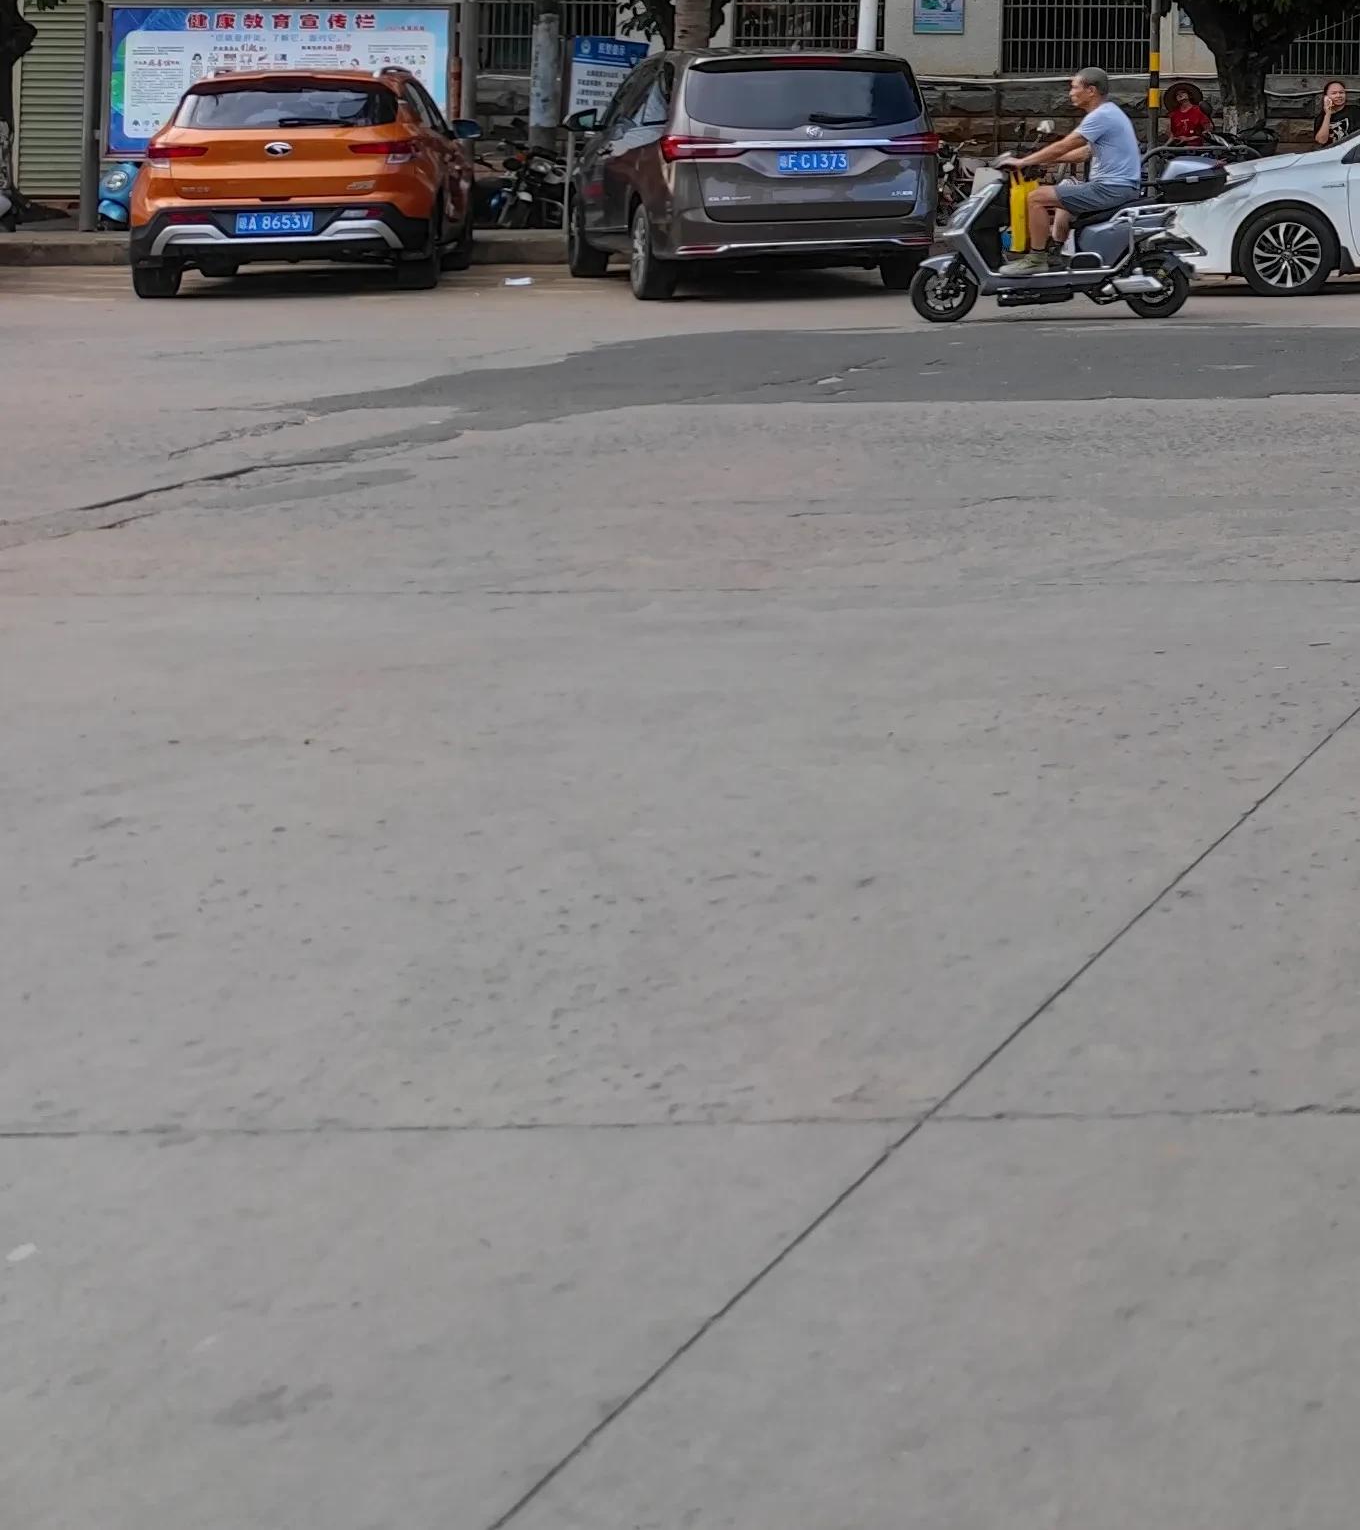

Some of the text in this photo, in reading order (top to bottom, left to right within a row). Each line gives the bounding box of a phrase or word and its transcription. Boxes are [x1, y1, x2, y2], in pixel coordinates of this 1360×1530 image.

[187, 13, 375, 30] 健康教育宣传栏
